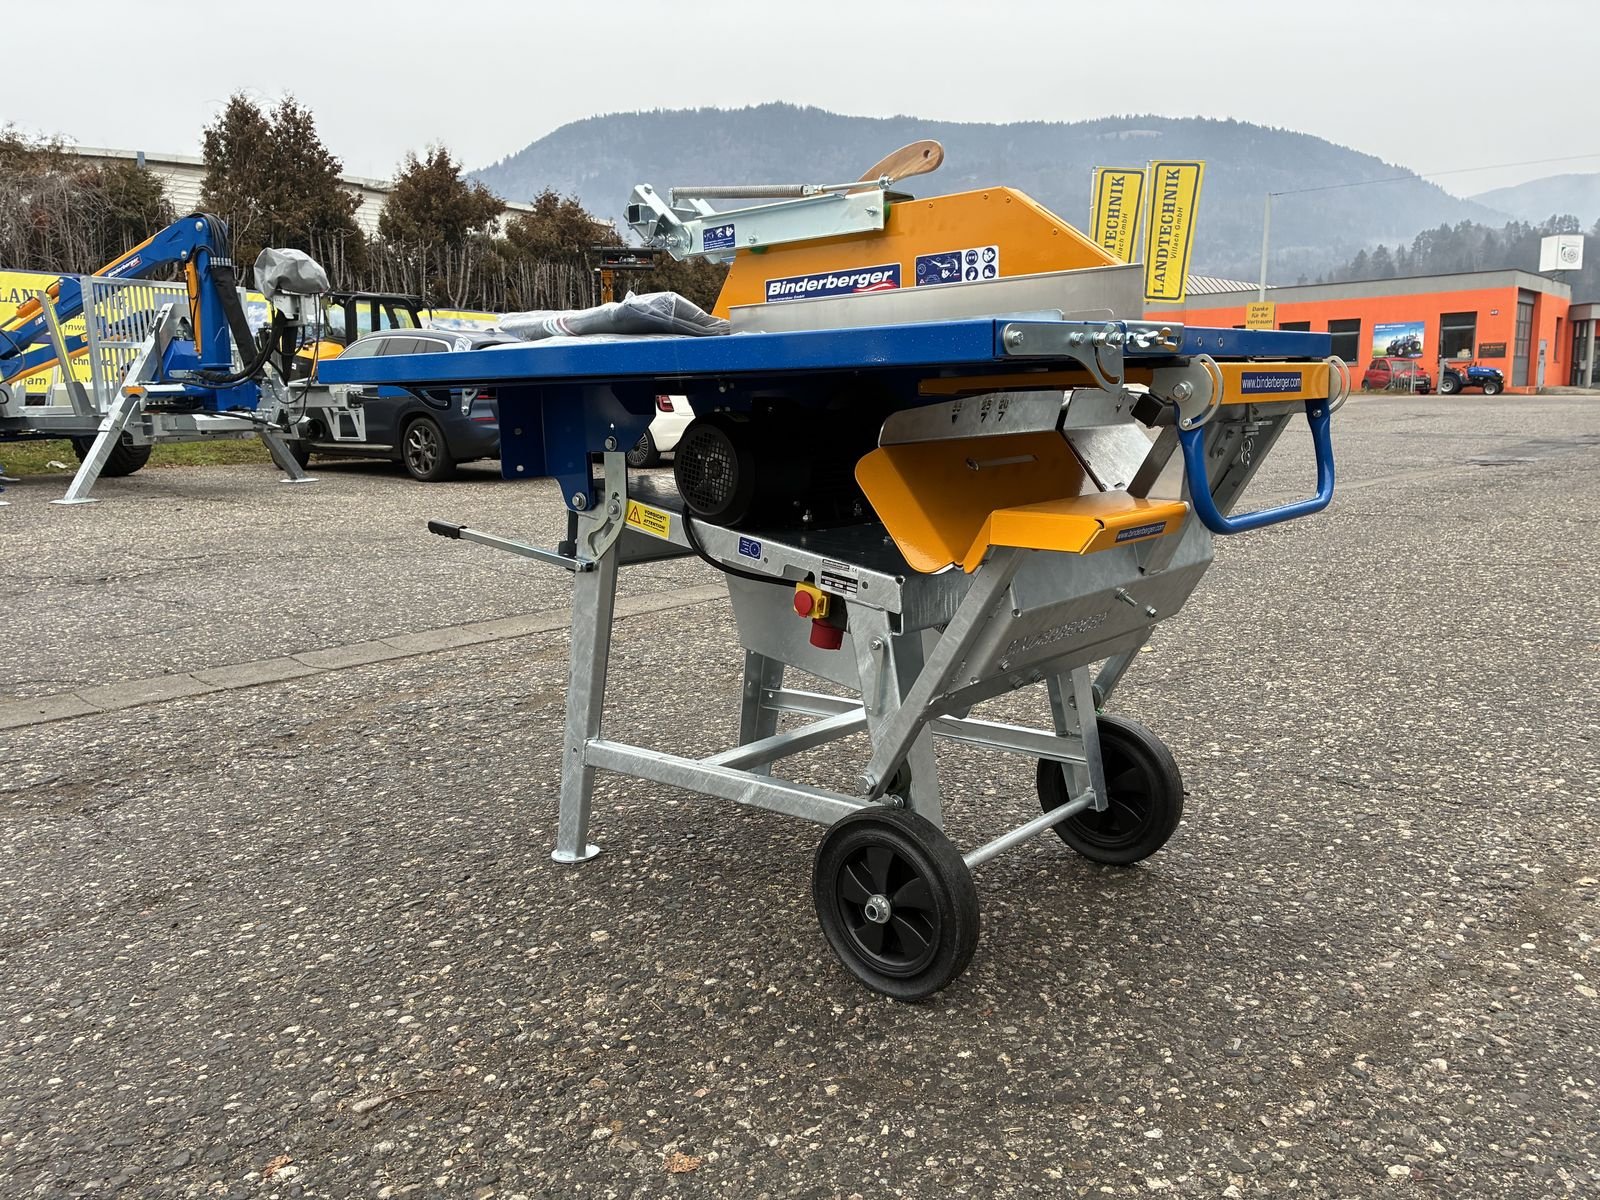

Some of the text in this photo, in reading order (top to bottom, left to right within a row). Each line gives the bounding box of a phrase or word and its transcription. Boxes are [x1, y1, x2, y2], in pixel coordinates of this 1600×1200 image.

[1120, 213, 1128, 236] GmbH
[1153, 168, 1181, 295] LANDTECHNIK
[1171, 207, 1184, 259] Villach GmbH
[767, 270, 894, 295] Binderberger
[1242, 376, 1301, 391] www.binderberger.com
